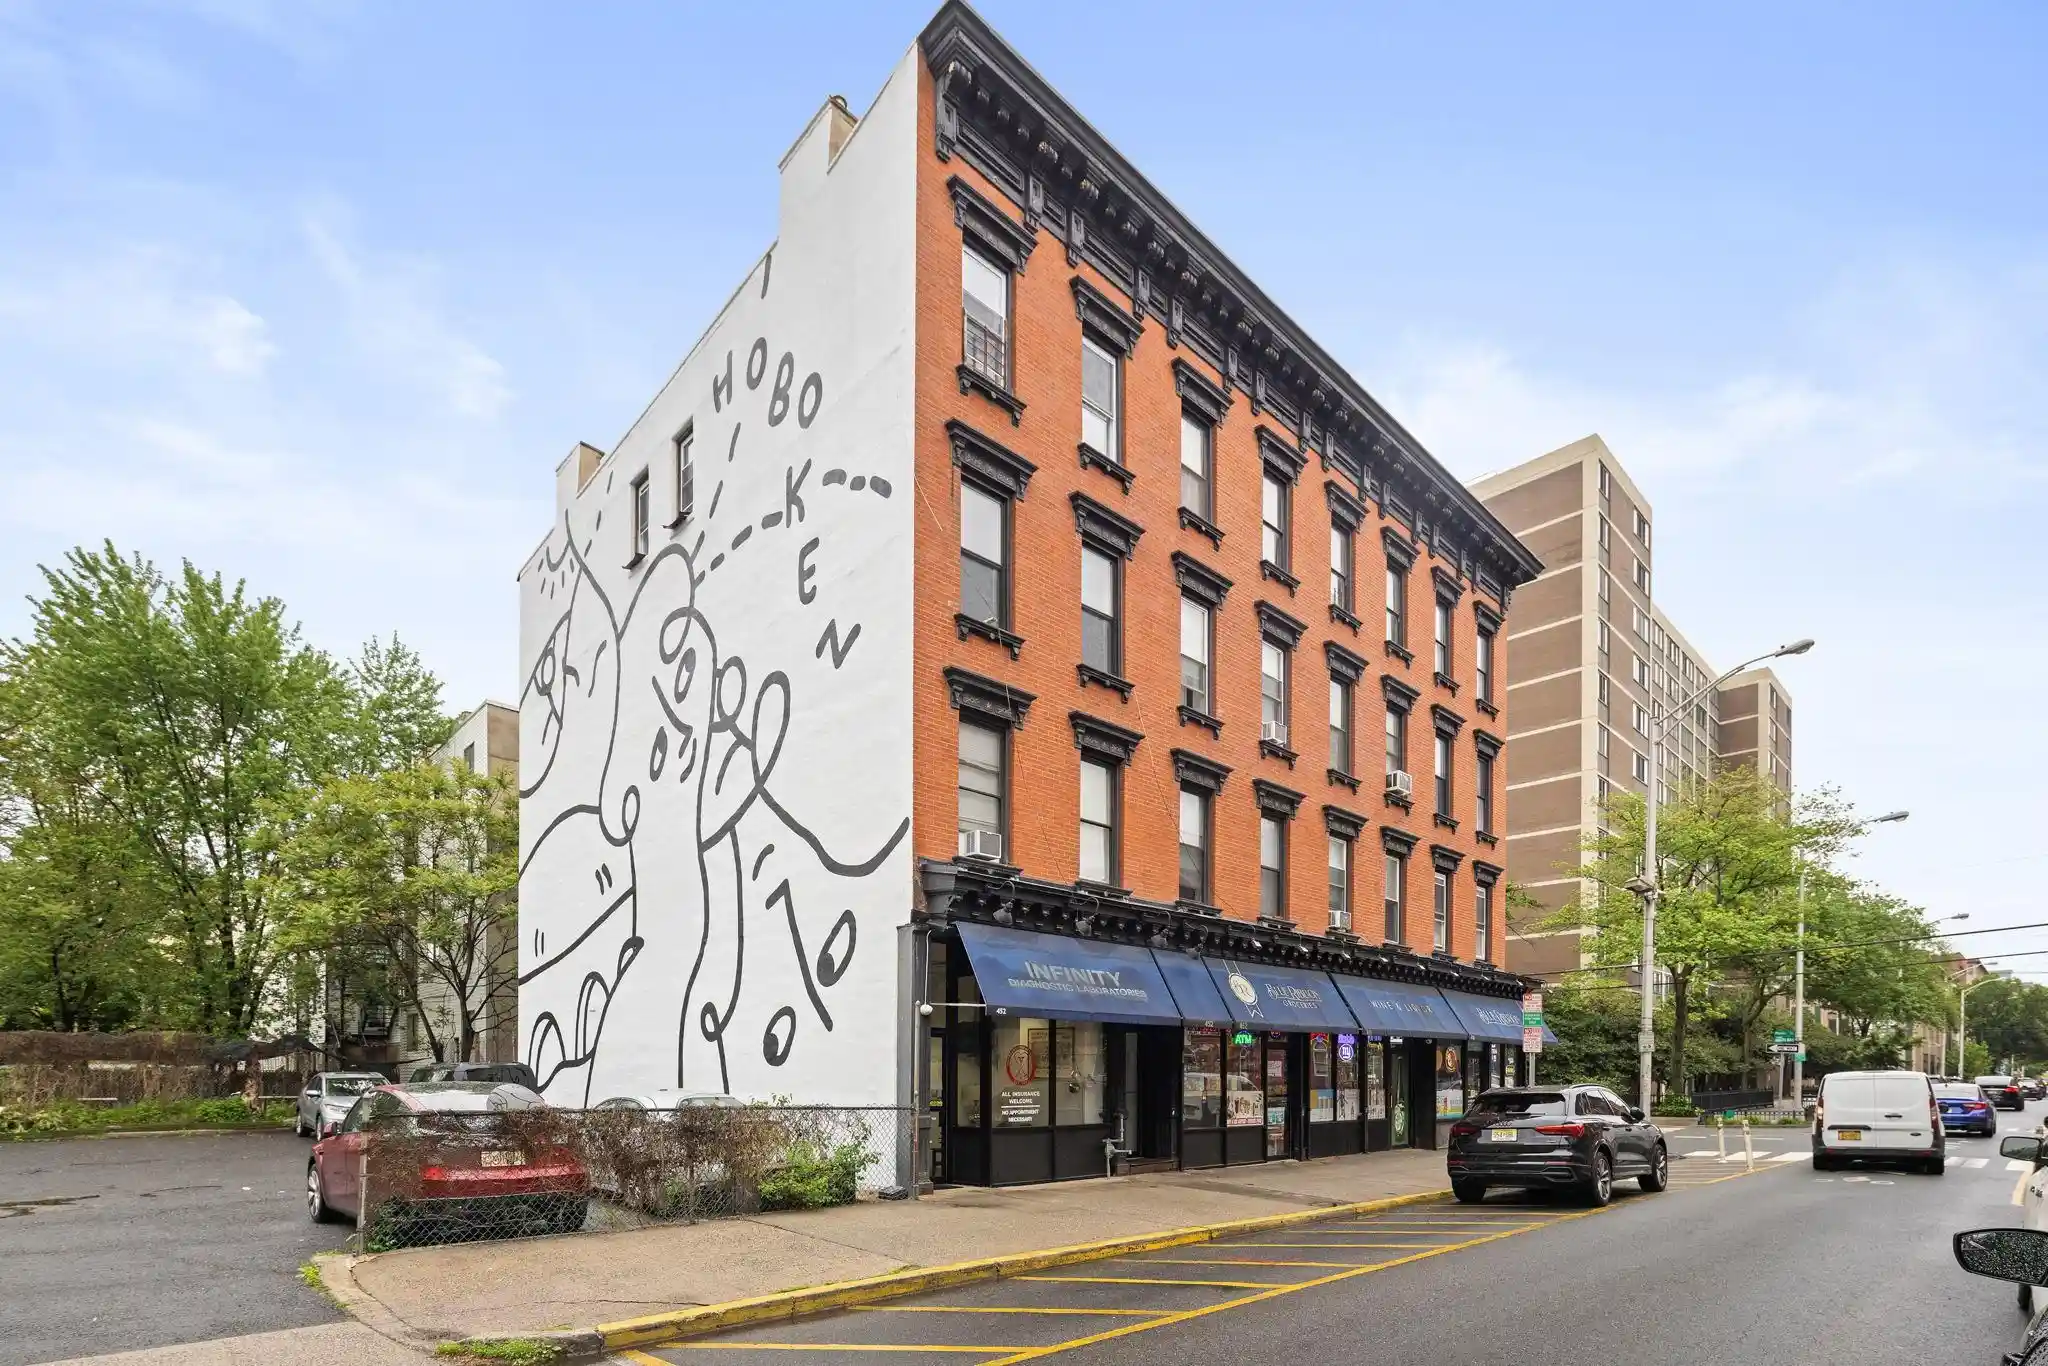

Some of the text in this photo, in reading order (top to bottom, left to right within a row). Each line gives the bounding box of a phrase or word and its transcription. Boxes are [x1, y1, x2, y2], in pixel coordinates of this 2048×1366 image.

[1024, 960, 1120, 986] INFINITY
[1008, 978, 1148, 999] DIAGNOSTIC LABORATORIES
[1283, 999, 1318, 1009] GROCERIES
[1370, 1000, 1393, 1010] WINE
[1404, 1003, 1433, 1013] LIQUOR
[996, 1007, 1007, 1015] 452
[1235, 1034, 1252, 1044] ATM
